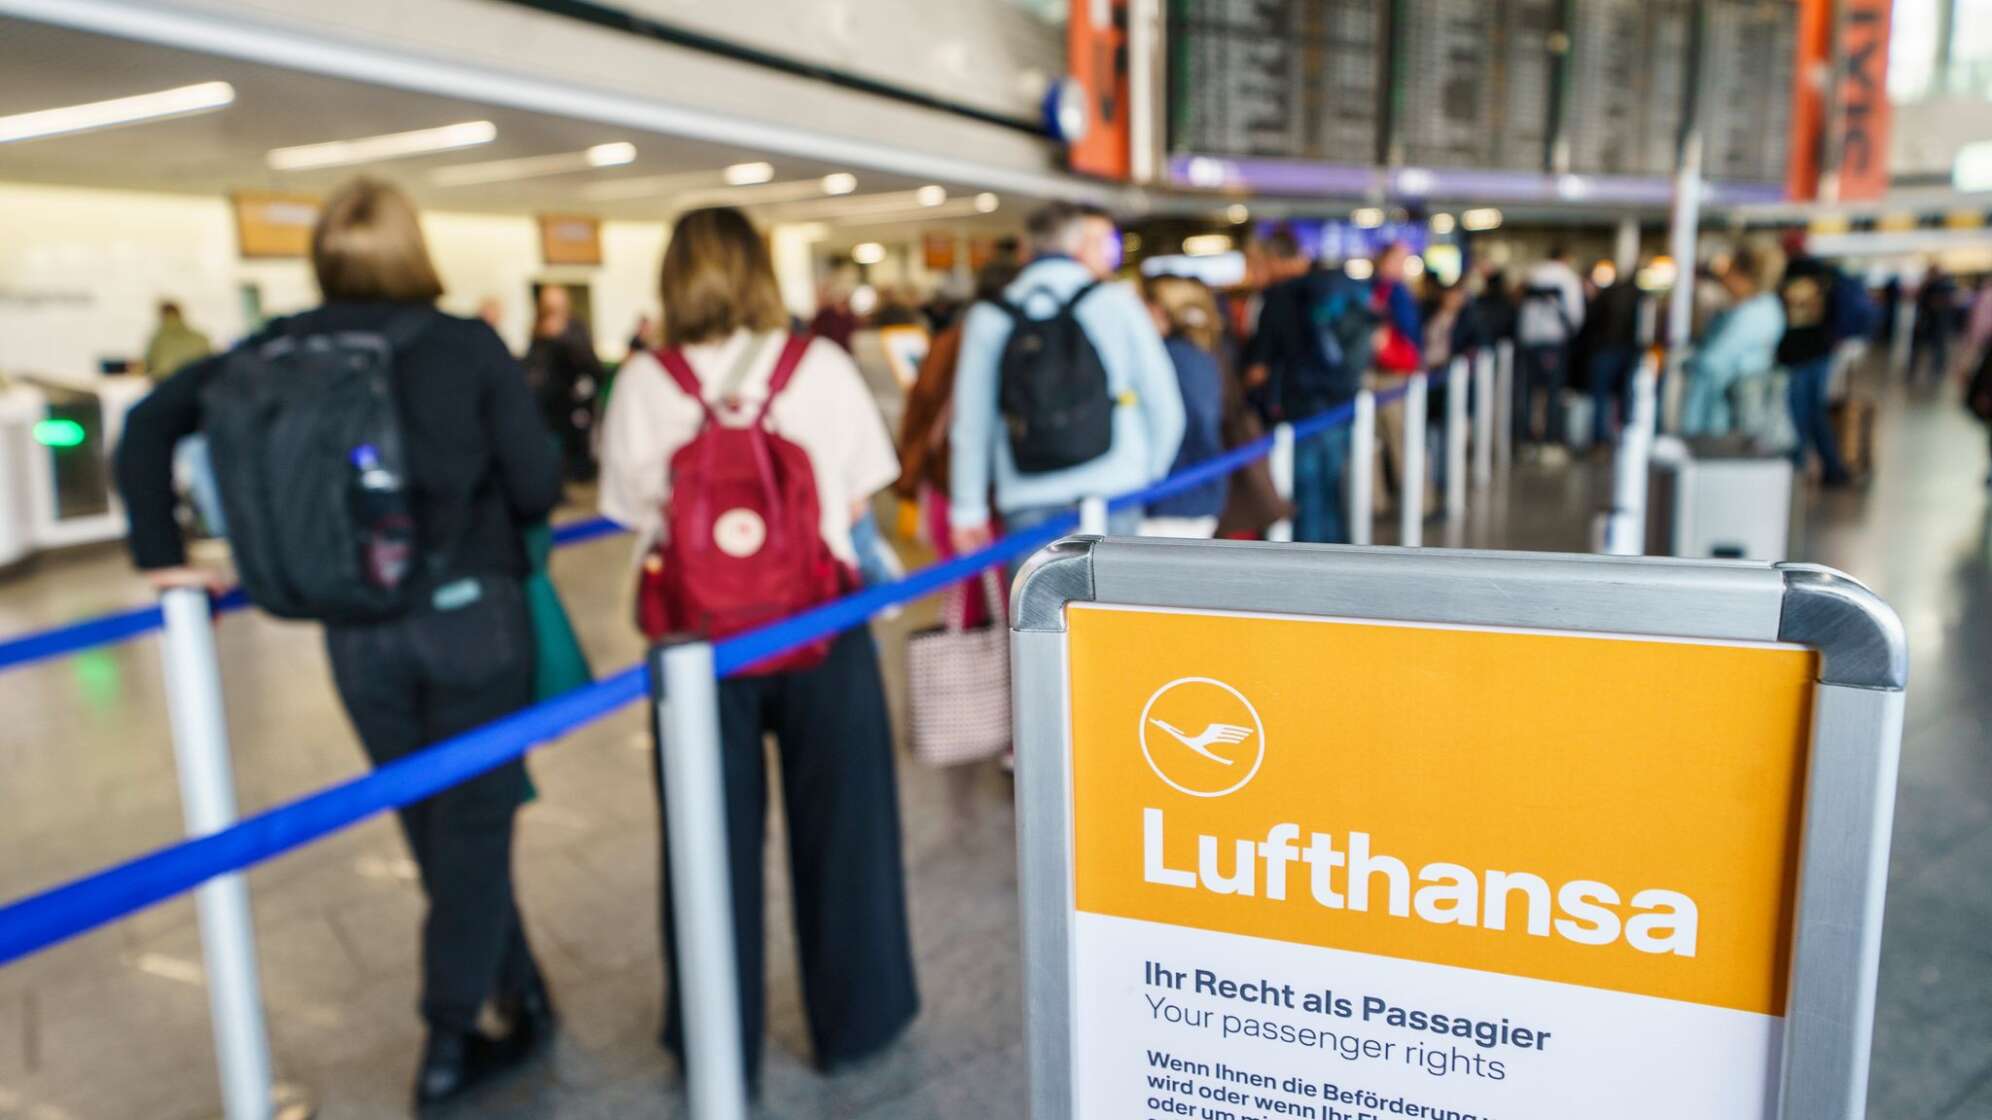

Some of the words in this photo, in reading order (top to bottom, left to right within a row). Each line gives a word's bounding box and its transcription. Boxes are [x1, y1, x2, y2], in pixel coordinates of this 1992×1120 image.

[1143, 807, 1698, 957] Lufthansa
[1144, 961, 1188, 990] Ihr
[1195, 969, 1296, 1008] Recht
[1302, 990, 1353, 1018] als
[1362, 996, 1552, 1052] Passagier
[1145, 993, 1215, 1029] Your
[1222, 1014, 1396, 1061] passenger
[1405, 1041, 1507, 1081] rights
[1147, 1049, 1210, 1077] Wenn
[1215, 1063, 1277, 1090] Ihnen
[1282, 1077, 1318, 1098] die
[1147, 1075, 1194, 1096] wird
[1199, 1086, 1250, 1106] oder
[1254, 1096, 1316, 1119] wenn
[1147, 1097, 1197, 1117] oder
